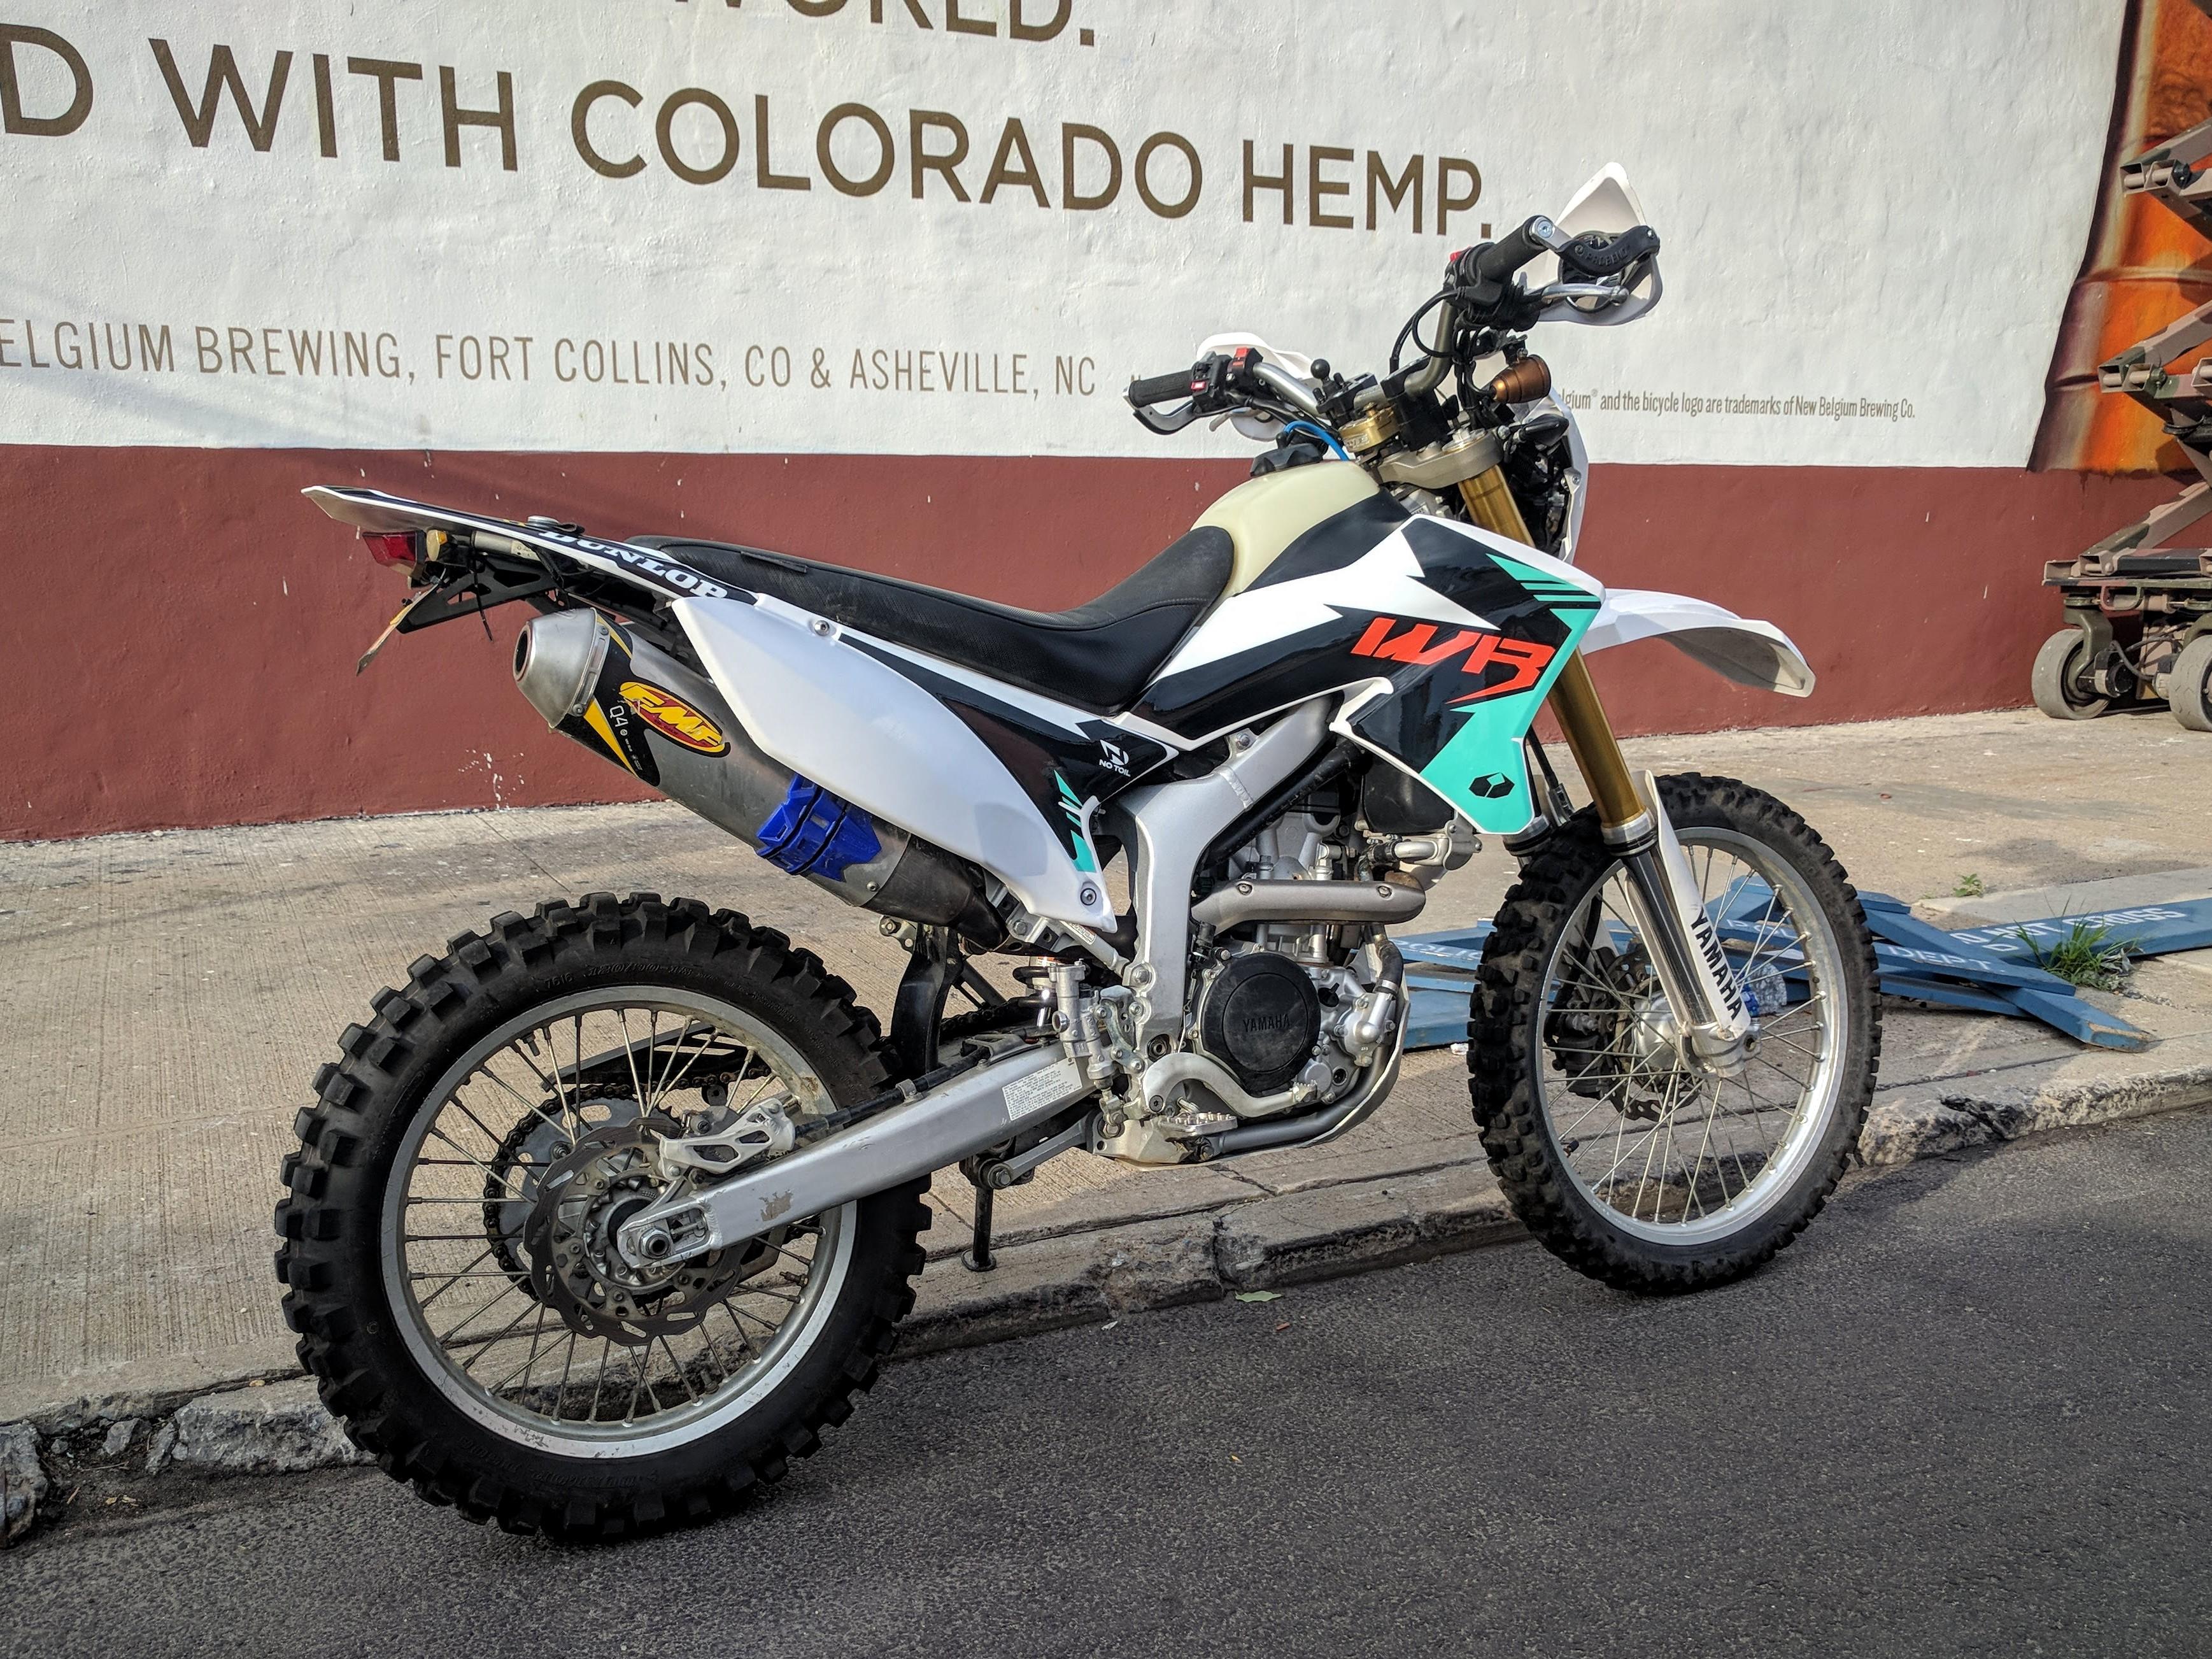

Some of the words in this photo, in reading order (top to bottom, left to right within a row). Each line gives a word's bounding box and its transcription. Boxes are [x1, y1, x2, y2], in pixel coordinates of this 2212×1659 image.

[148, 38, 518, 171] WITH
[571, 80, 1202, 218] COLORADO
[1243, 139, 1491, 239] HEMP.
[0, 319, 174, 372] ELGIUM
[195, 325, 415, 385] BREWING,
[436, 335, 533, 381] FORT
[555, 338, 727, 391] COLLINS,
[745, 345, 791, 388] CO
[811, 348, 832, 389] &
[849, 348, 1039, 401] ASHEVILLE,
[1056, 355, 1095, 396] NC
[1600, 390, 1620, 410] and
[1623, 390, 1640, 411] the
[1643, 390, 1678, 417] bicycle
[1681, 392, 1703, 417] logo
[1705, 398, 1722, 413] are
[1725, 394, 1781, 415] trademarks
[1783, 395, 1795, 415] of
[1796, 395, 1817, 416] New
[1819, 396, 1857, 421] Belgium
[1859, 397, 1899, 422] Brewing
[1900, 398, 1915, 418] Co.
[539, 531, 728, 598] DUNLOP
[1350, 617, 1556, 704] WR
[609, 705, 628, 727] Q4
[618, 684, 723, 747] FMF
[1099, 758, 1113, 769] NO
[1113, 764, 1131, 777] TOIL
[1691, 906, 1743, 1022] YAMAHA
[1887, 945, 2006, 973] DEPT.
[1242, 1013, 1291, 1032] YAMAHA
